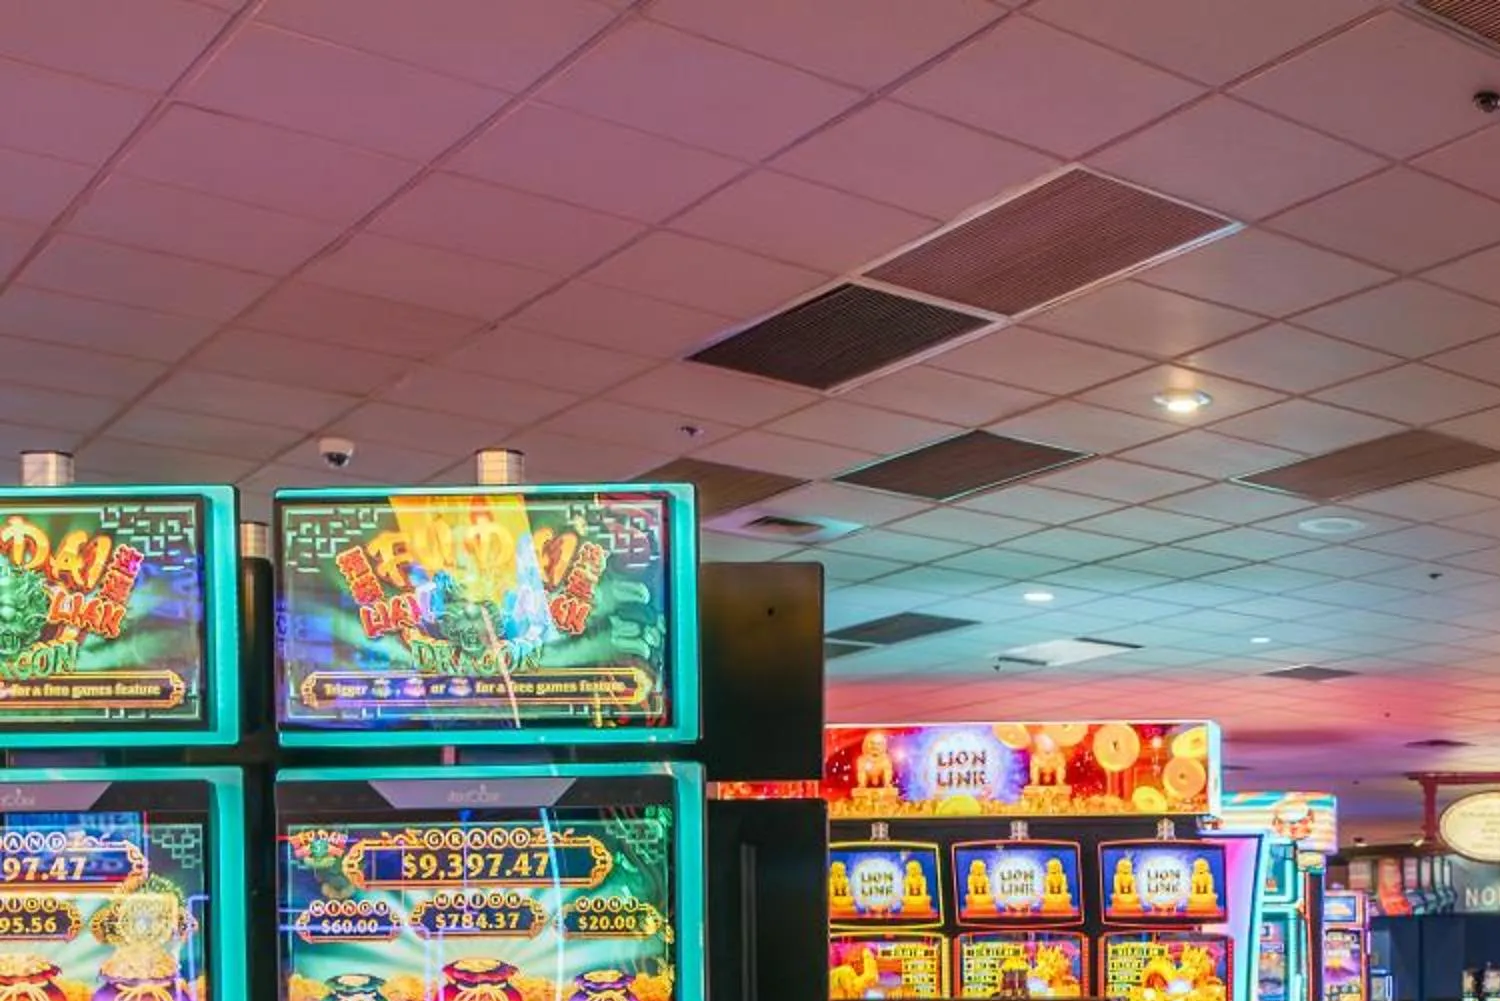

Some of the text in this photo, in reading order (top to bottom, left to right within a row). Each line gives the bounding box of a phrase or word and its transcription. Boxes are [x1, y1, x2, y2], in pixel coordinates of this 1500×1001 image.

[115, 684, 160, 696] feature
[323, 683, 368, 697] Trigger
[430, 685, 446, 694] or
[475, 681, 494, 693] for
[535, 683, 577, 696] games
[936, 750, 987, 767] LION
[936, 771, 988, 788] LINK
[427, 830, 528, 846] GRAND
[403, 853, 549, 880] $9,397.47
[861, 872, 893, 884] LION
[1000, 870, 1034, 882] LION
[1147, 870, 1181, 881] LION
[321, 919, 378, 934] $60.00
[435, 913, 520, 930] $784.37
[579, 915, 636, 931] $20.00
